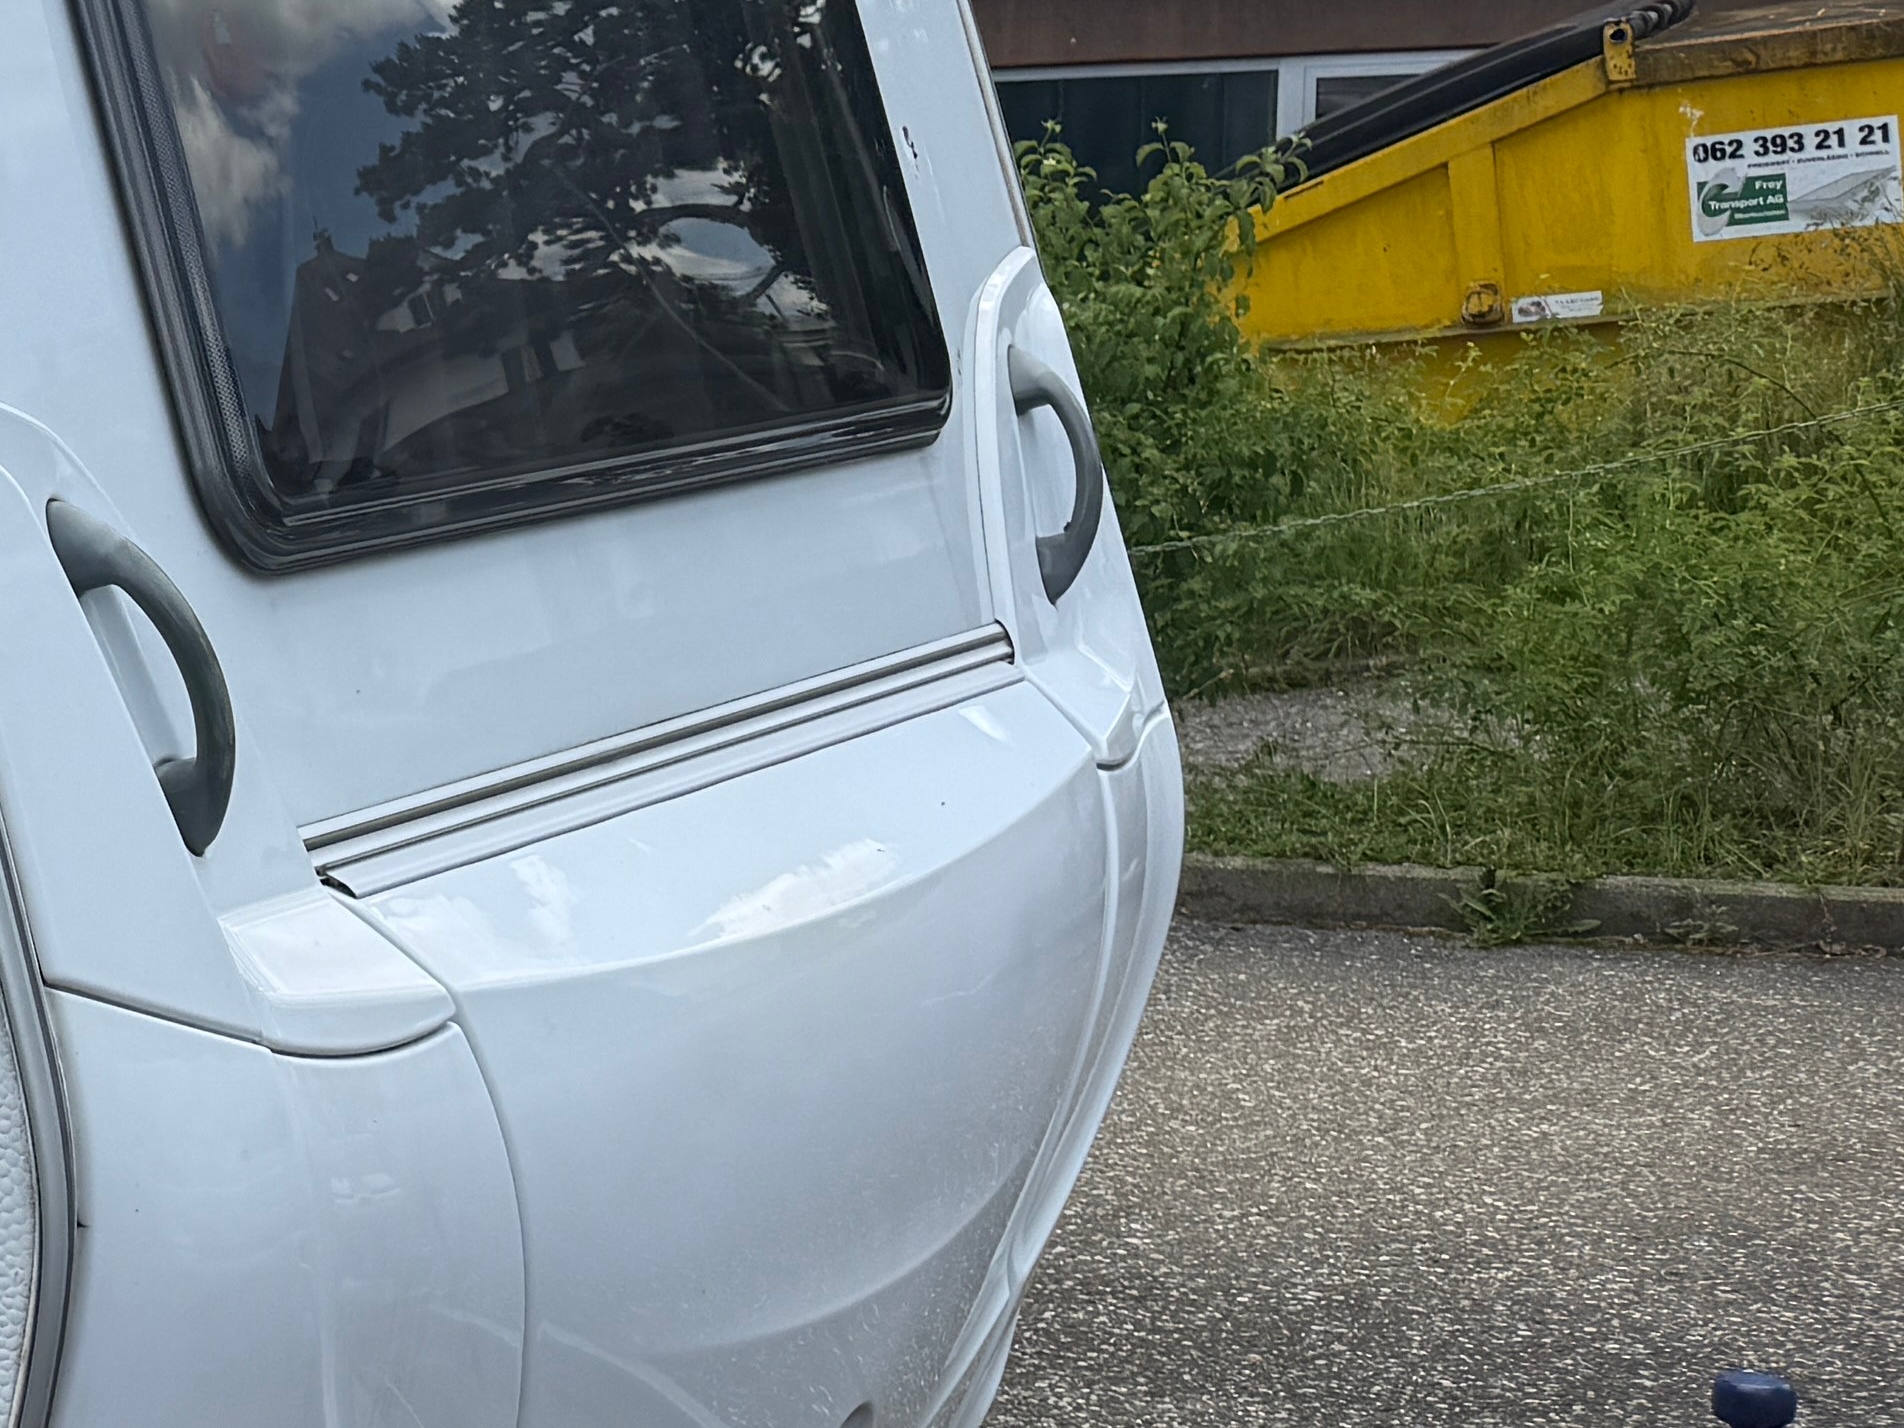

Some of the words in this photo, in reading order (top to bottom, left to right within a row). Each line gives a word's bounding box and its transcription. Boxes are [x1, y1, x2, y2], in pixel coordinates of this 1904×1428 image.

[1693, 139, 1745, 163] 062
[1753, 132, 1805, 157] 393
[1814, 127, 1846, 150] 21
[1858, 122, 1890, 145] 21
[1755, 180, 1783, 190] Frey
[1708, 196, 1764, 210] Transport
[1766, 194, 1784, 204] AG
